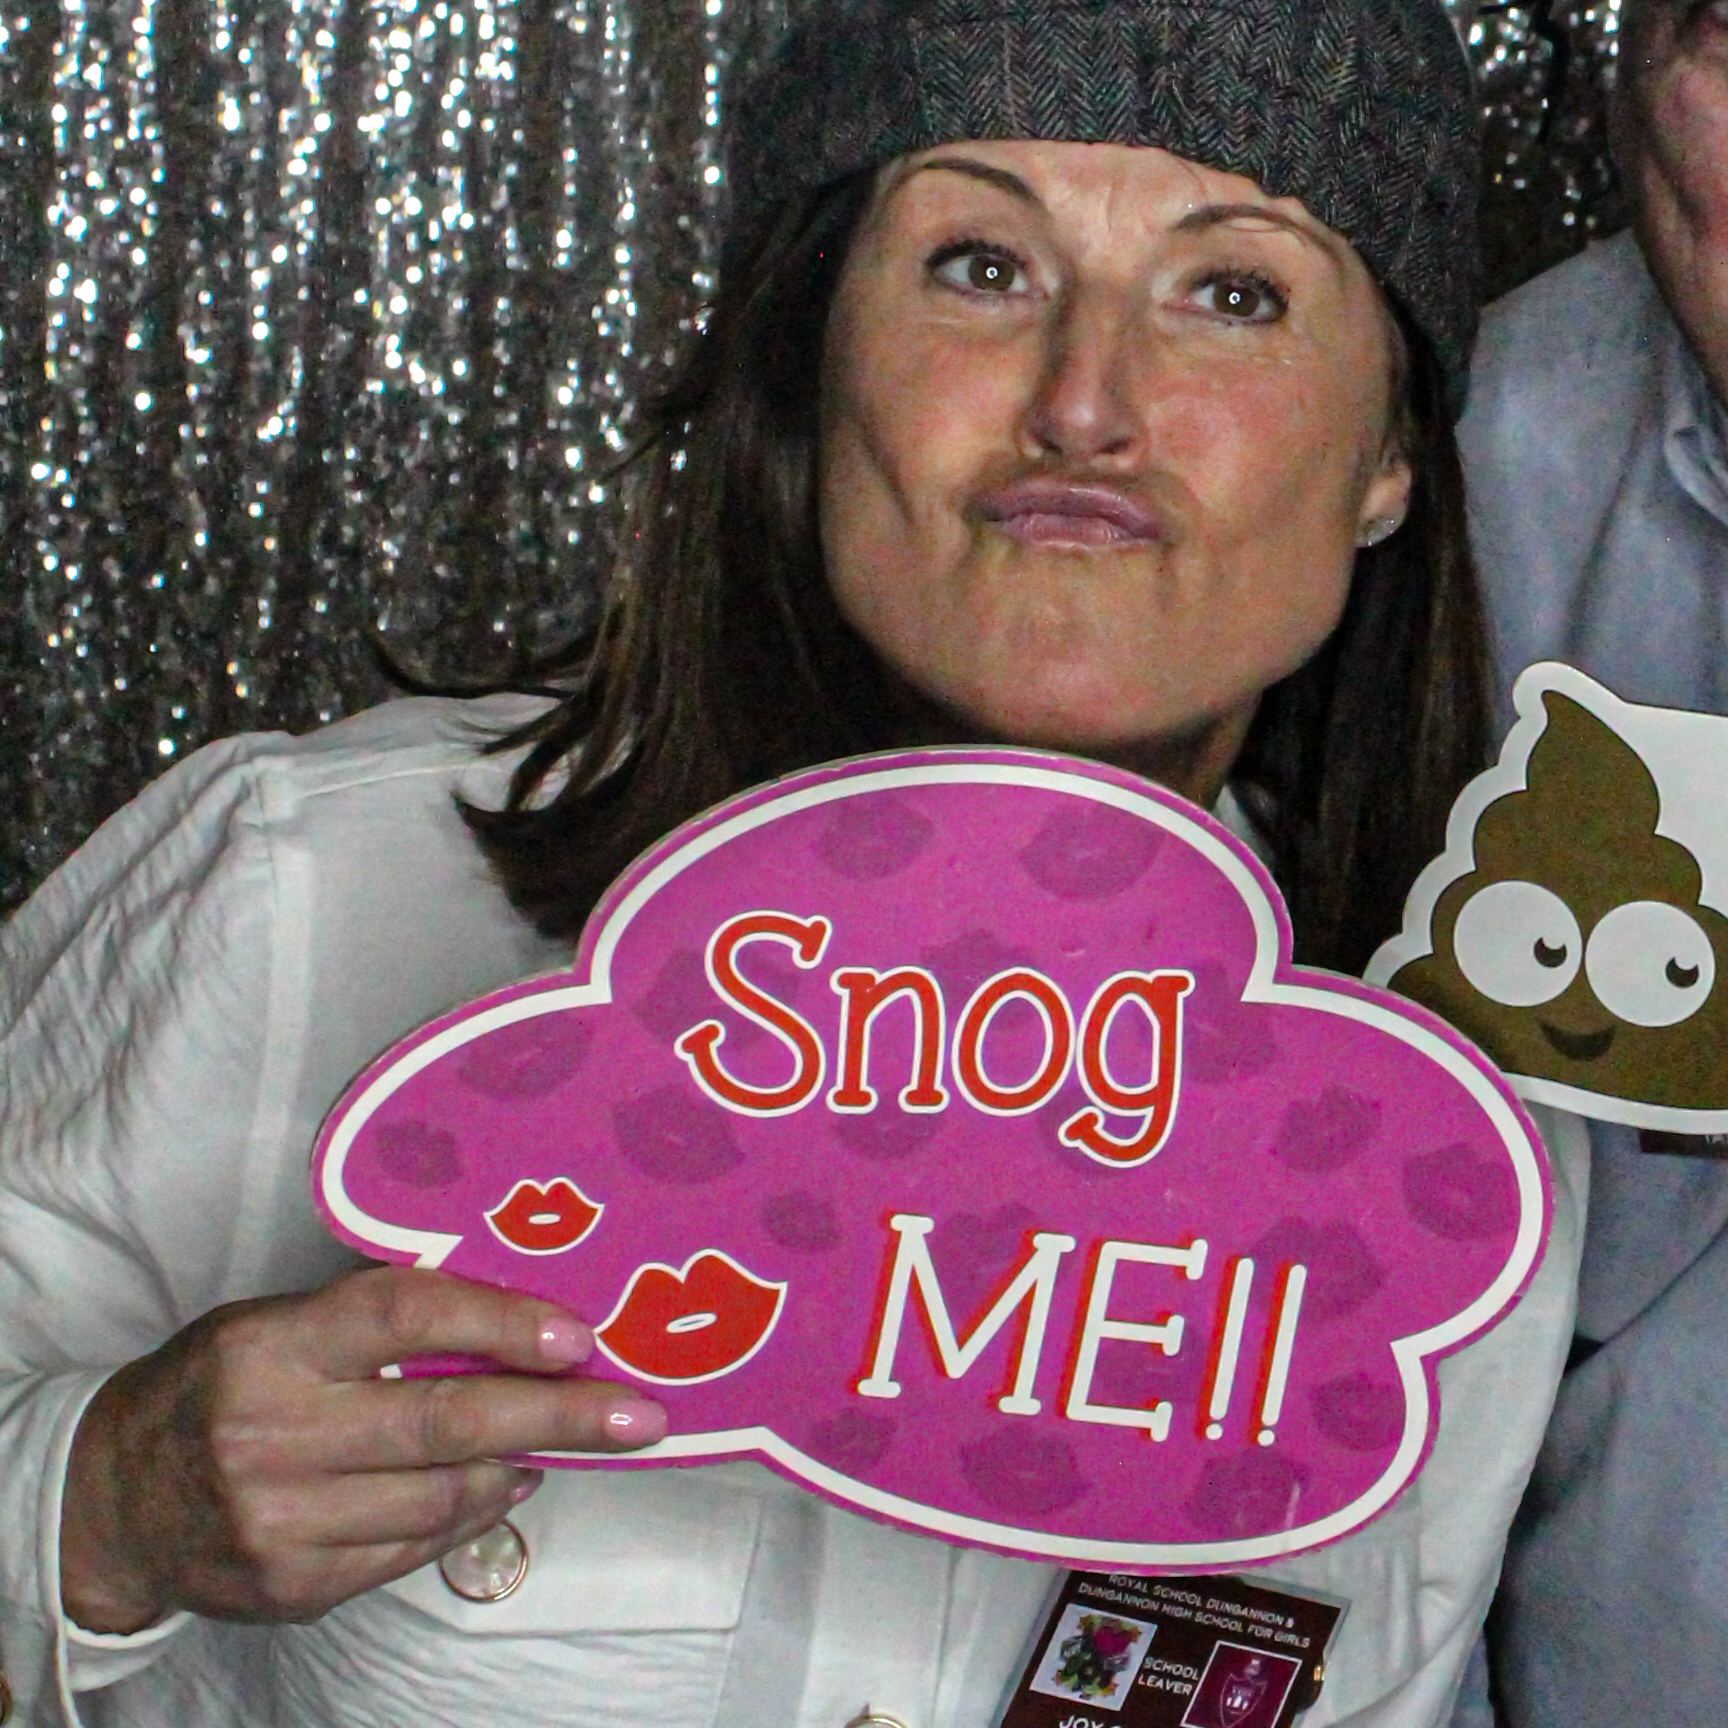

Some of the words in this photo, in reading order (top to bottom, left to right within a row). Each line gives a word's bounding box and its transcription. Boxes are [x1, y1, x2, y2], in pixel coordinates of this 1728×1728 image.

[675, 910, 1193, 1168] Snog
[848, 1212, 1307, 1449] ME!!
[1078, 1581, 1160, 1612] DUNGANNON
[1161, 1603, 1193, 1619] HIGH
[1194, 1611, 1243, 1633] SCHOOL
[1247, 1624, 1273, 1640] FOR
[1274, 1630, 1311, 1649] GIRLS
[1108, 1574, 1149, 1594] ROYAL
[1153, 1584, 1203, 1607] SCHOOL
[1206, 1597, 1285, 1627] DUNGANNON
[1138, 1673, 1193, 1696] LEAVER
[1143, 1656, 1200, 1681] SCHOOL
